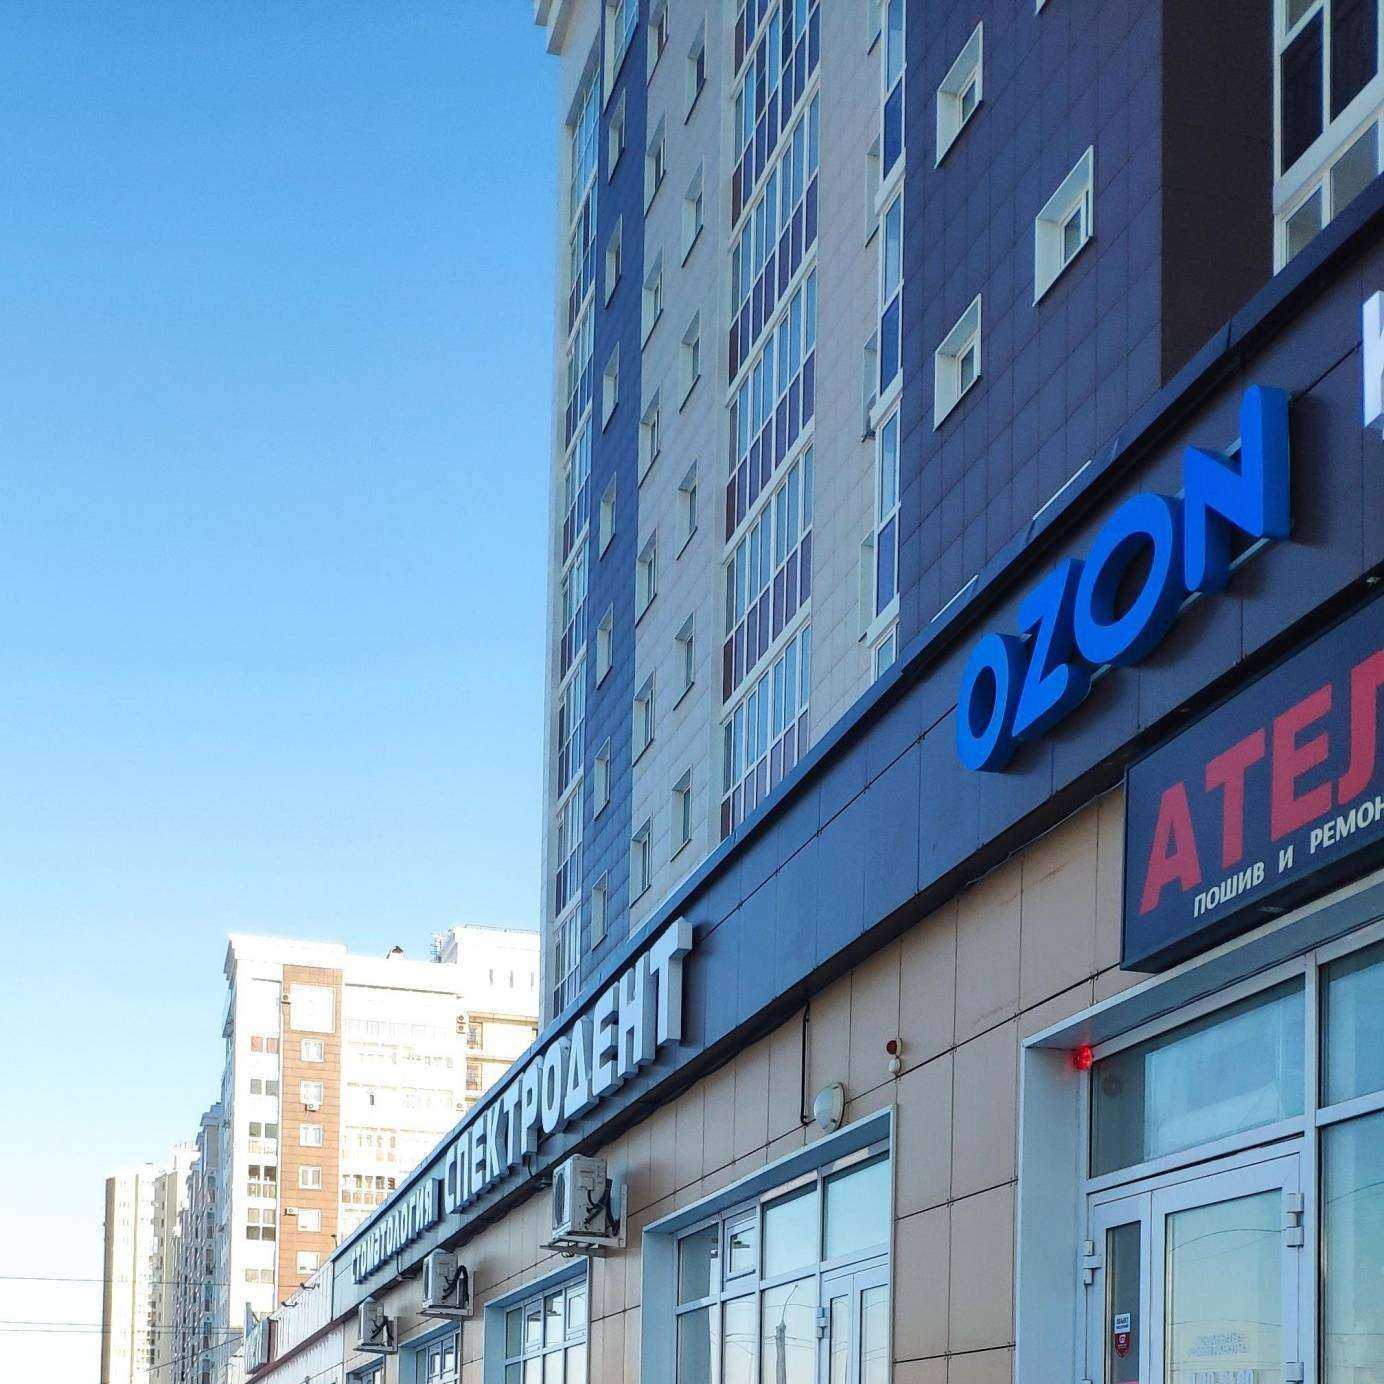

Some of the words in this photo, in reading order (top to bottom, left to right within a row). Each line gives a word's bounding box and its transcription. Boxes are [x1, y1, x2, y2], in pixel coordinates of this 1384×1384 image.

[956, 384, 1290, 772] OZON
[1193, 861, 1264, 918] ПОШИВ
[1278, 845, 1294, 873] И
[352, 1178, 438, 1285] СТОМАТОЛОГИЯ
[444, 916, 692, 1215] СПЕКТРОДЕНТ
